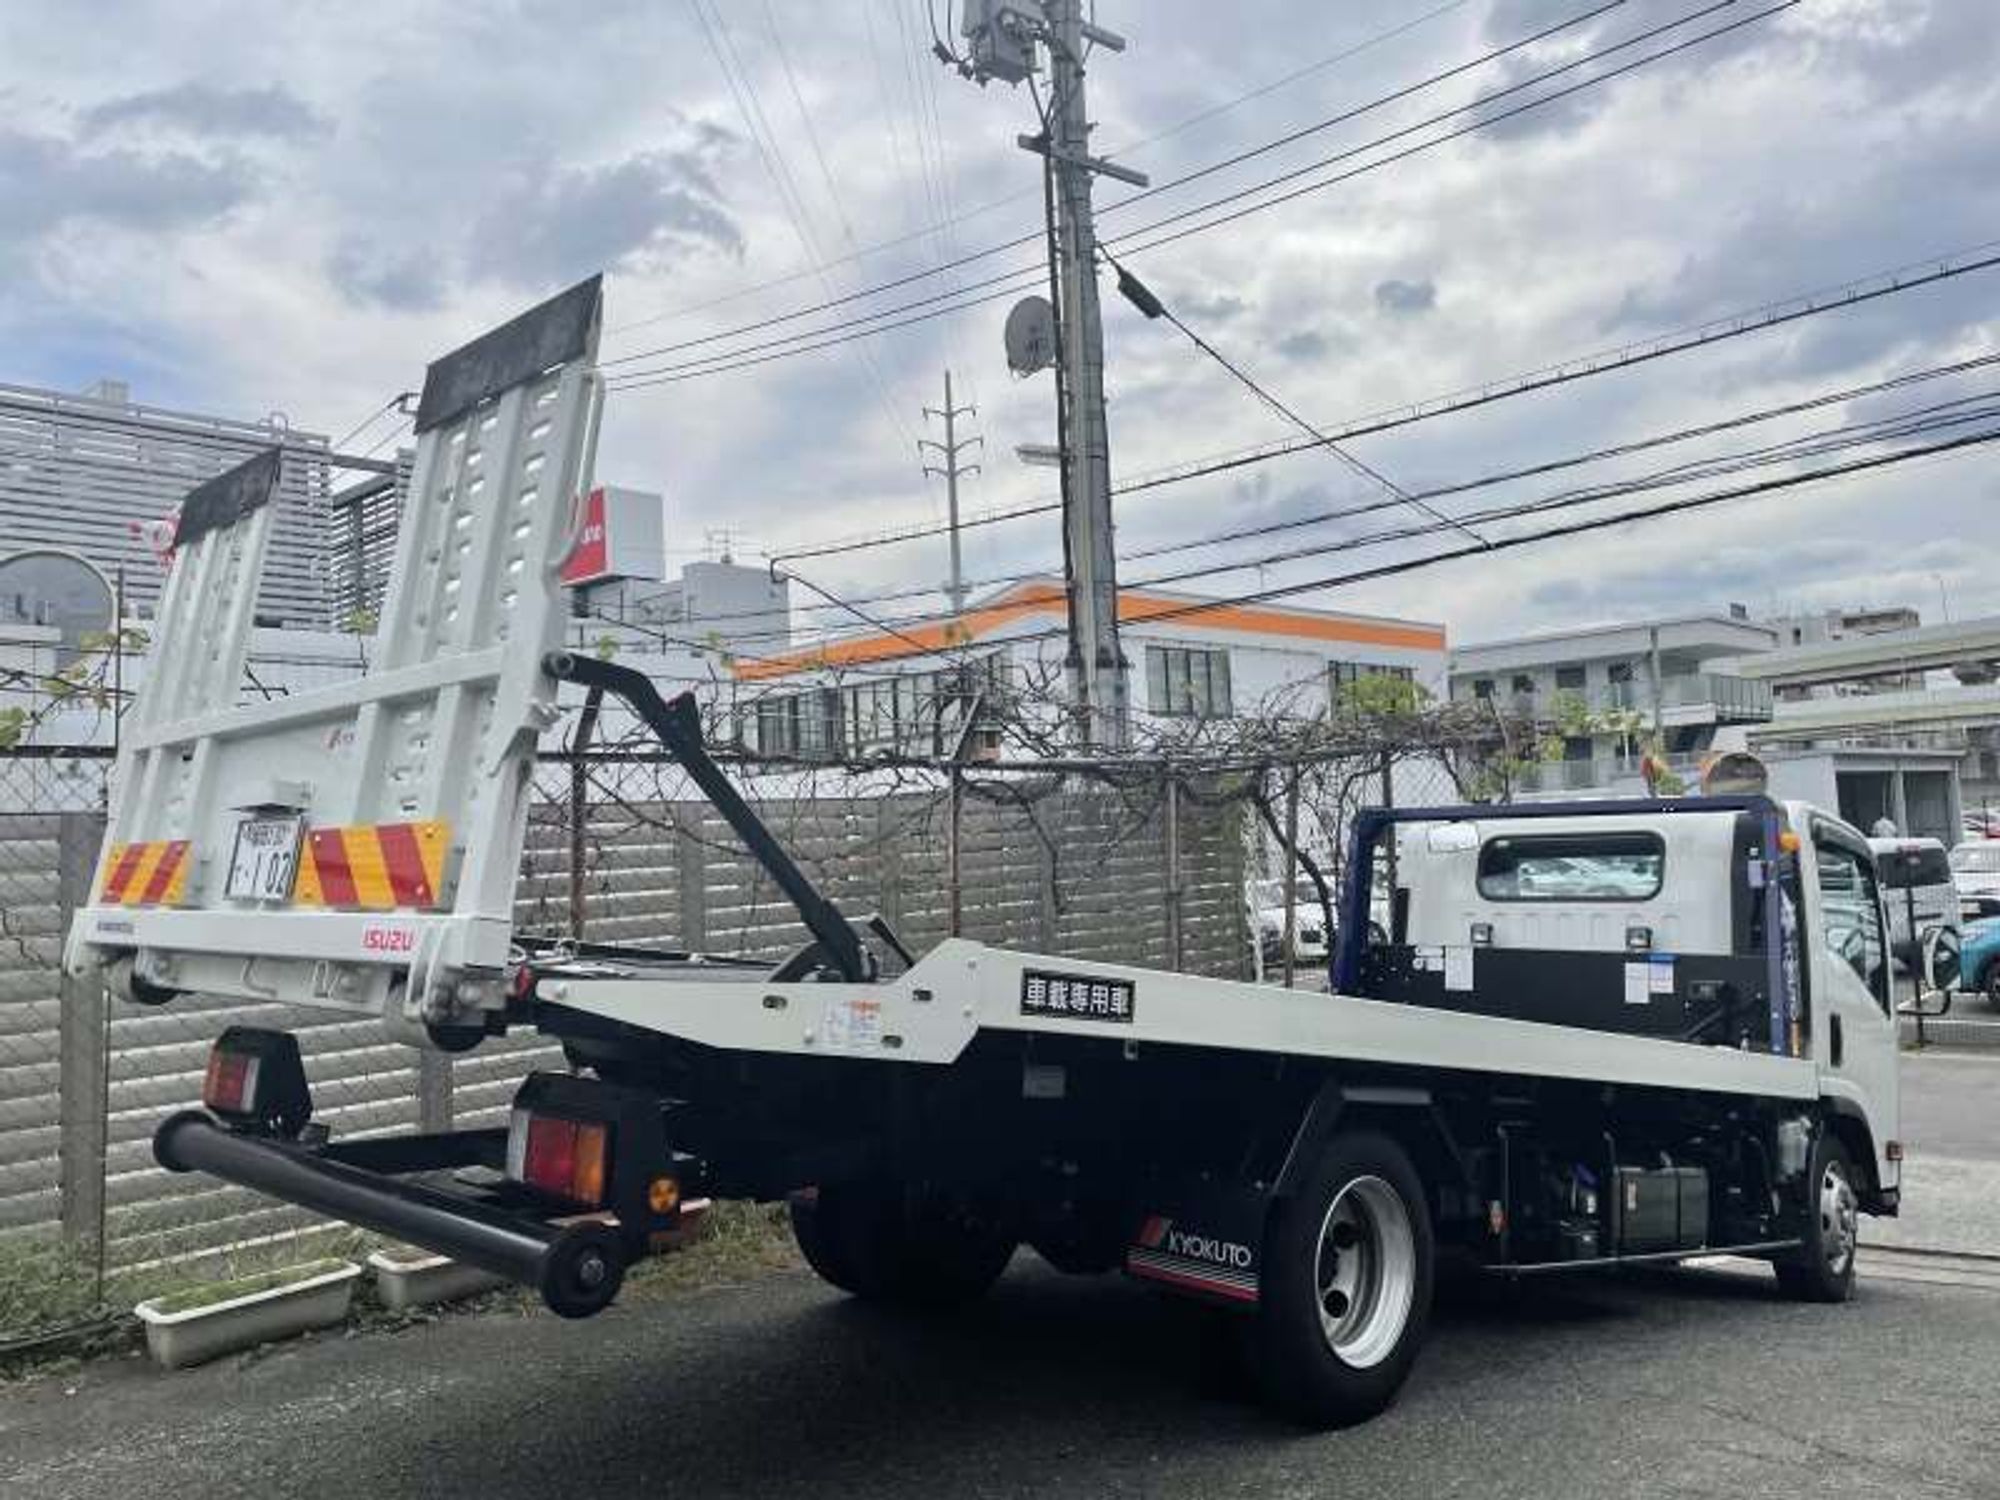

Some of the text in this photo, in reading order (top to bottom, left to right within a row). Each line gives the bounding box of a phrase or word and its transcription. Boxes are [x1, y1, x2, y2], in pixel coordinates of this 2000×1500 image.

[363, 929, 414, 951] ISUZU
[1025, 976, 1129, 1014] 車載専用車
[1168, 1230, 1252, 1267] KYOKUTO
